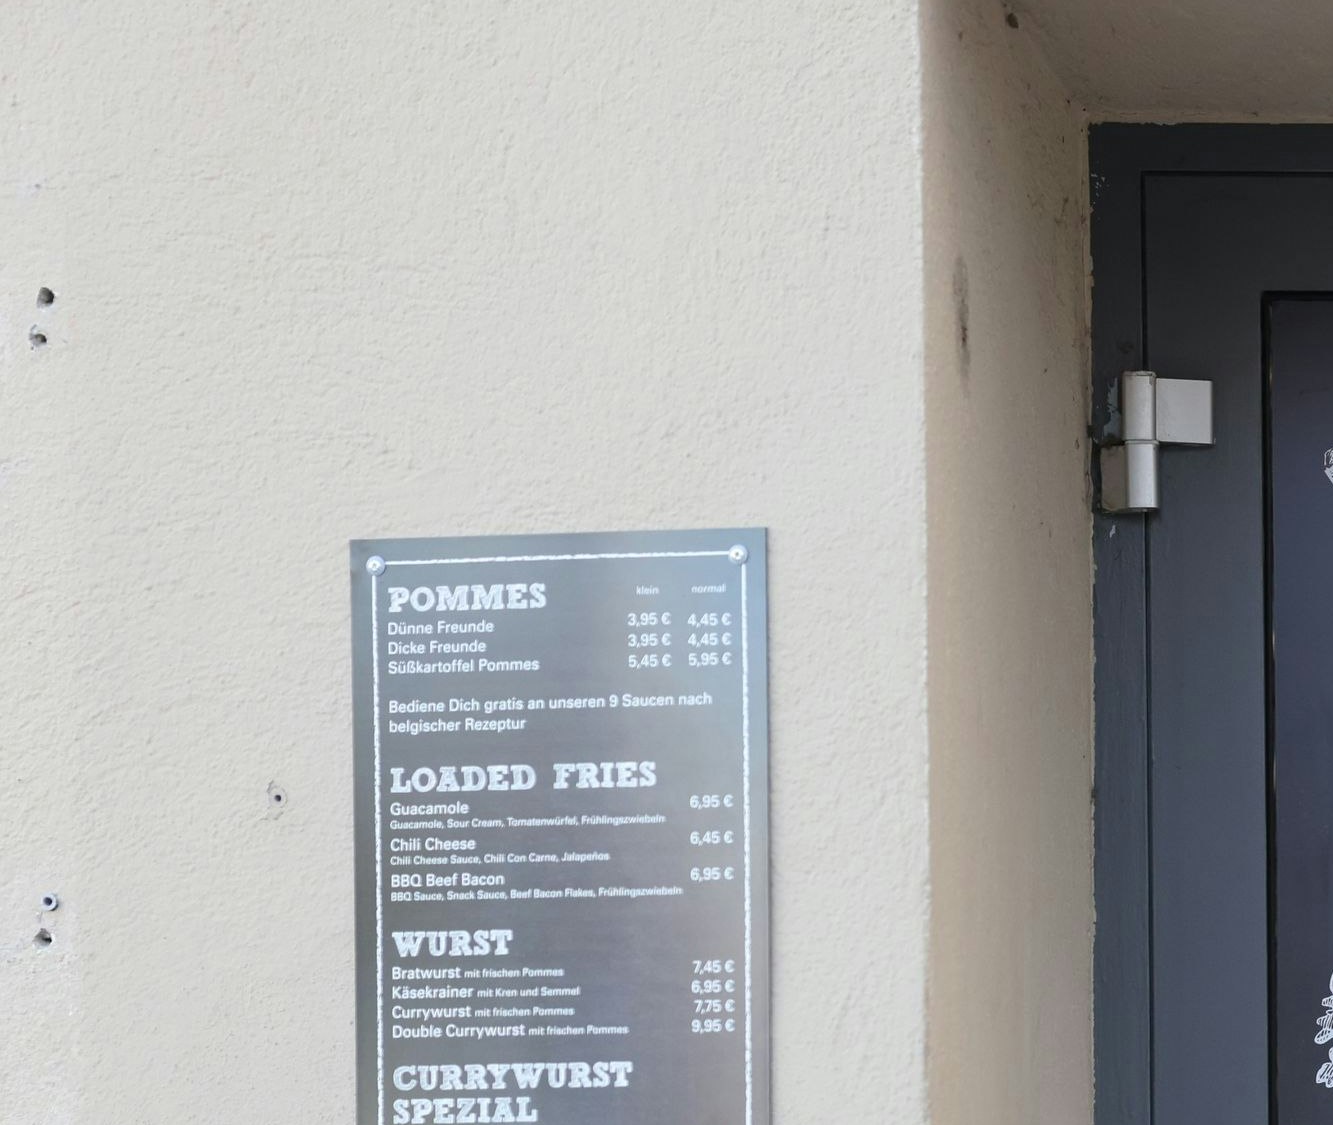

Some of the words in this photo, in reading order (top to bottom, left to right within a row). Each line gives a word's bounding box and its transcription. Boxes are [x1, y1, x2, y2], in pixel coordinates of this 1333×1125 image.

[387, 582, 546, 613] POMMES
[387, 621, 433, 635] Dünne
[437, 619, 494, 634] Freunde
[628, 612, 657, 627] 3,95
[388, 658, 474, 674] Süßkartoffel
[478, 658, 539, 671] Pommes
[628, 654, 658, 668] 5,45
[389, 699, 445, 713] Bediene
[448, 697, 480, 711] Dich
[483, 696, 524, 713] gratis
[609, 694, 618, 707] 9
[622, 693, 673, 707] Saucen
[678, 692, 712, 705] nach
[389, 718, 461, 735] belgischer
[464, 717, 526, 733] Rezeptur
[390, 764, 536, 793] LOADED
[553, 760, 656, 789] FRIES
[389, 800, 469, 816] Guacamole
[391, 928, 513, 957] WURST
[392, 966, 461, 980] Bratwurst
[392, 984, 474, 999] Käsekrainer
[392, 1060, 633, 1091] CURRYWURST
[392, 1096, 538, 1125] SPEZIAL
